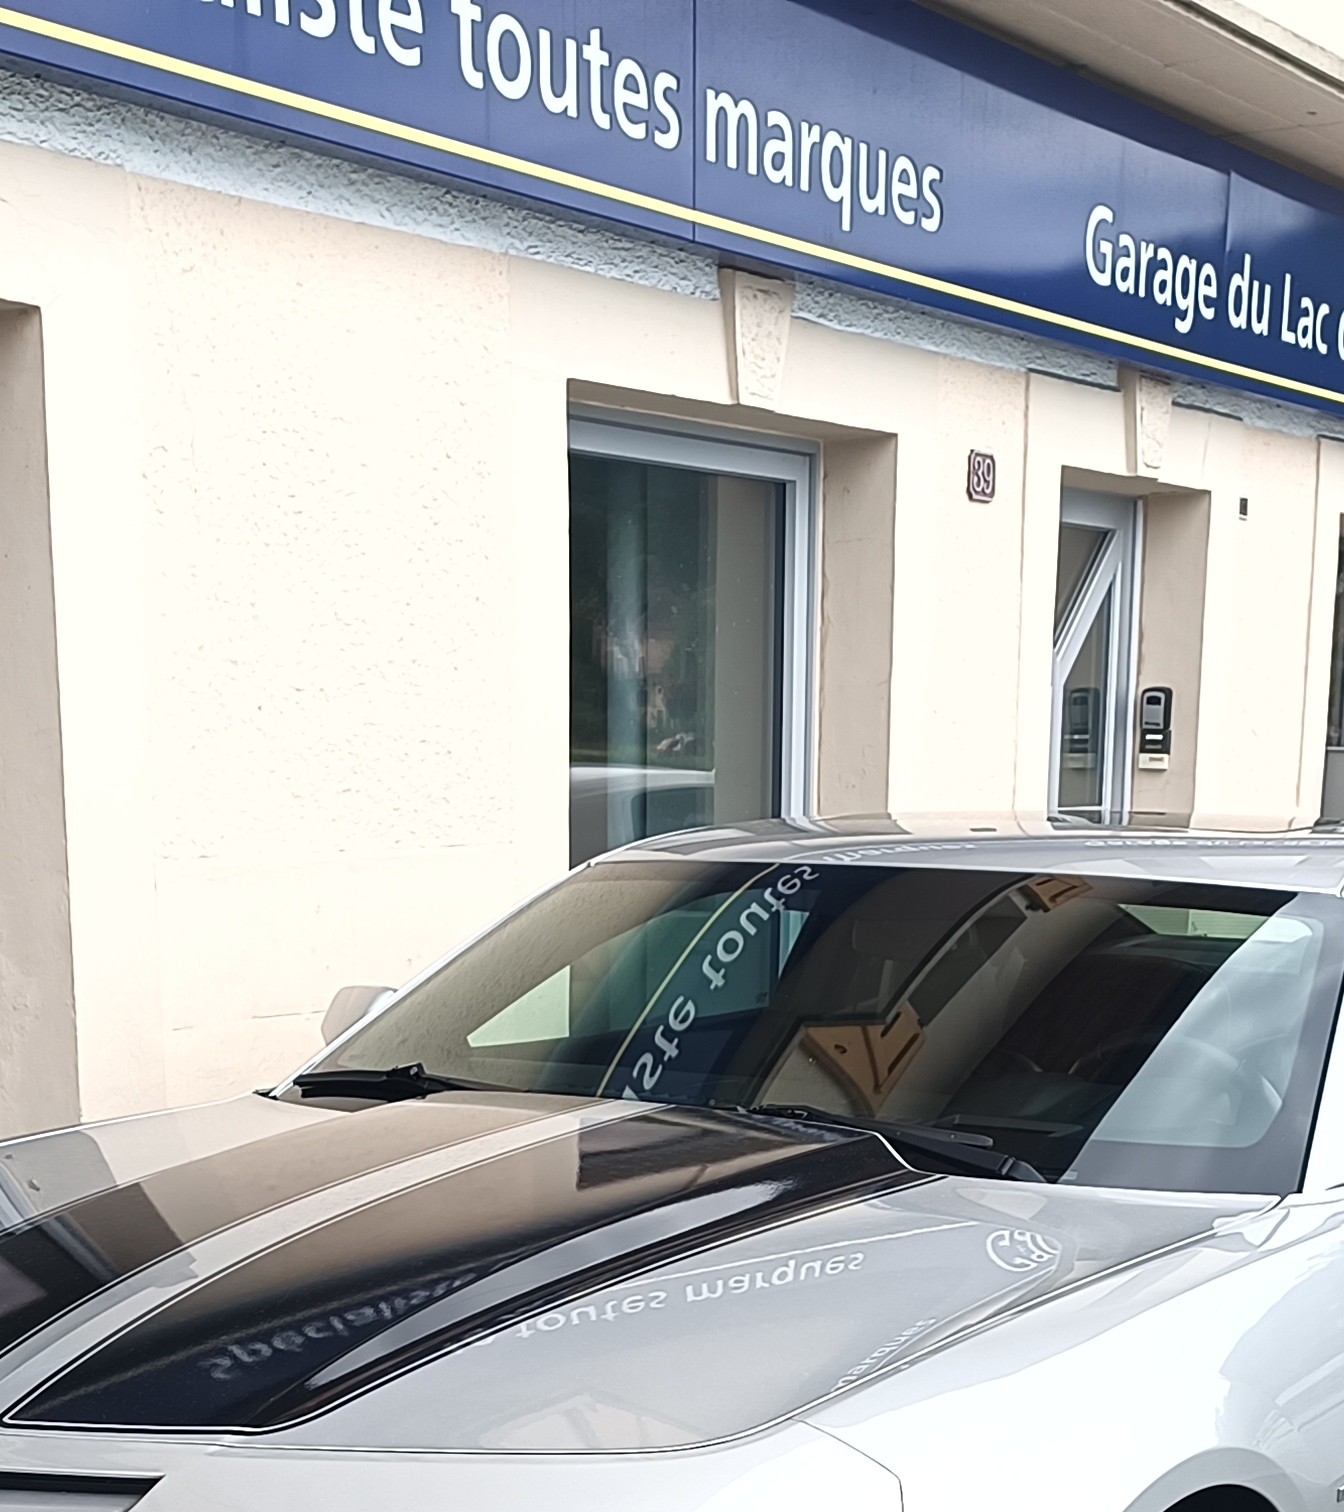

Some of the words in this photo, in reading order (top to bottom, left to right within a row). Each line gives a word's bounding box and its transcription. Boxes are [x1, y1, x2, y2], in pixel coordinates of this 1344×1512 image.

[450, 0, 680, 150] toutes
[705, 88, 941, 233] marques
[1084, 204, 1219, 334] Garage
[1226, 249, 1271, 338] du
[1281, 272, 1330, 355] Lac
[973, 456, 993, 495] 39
